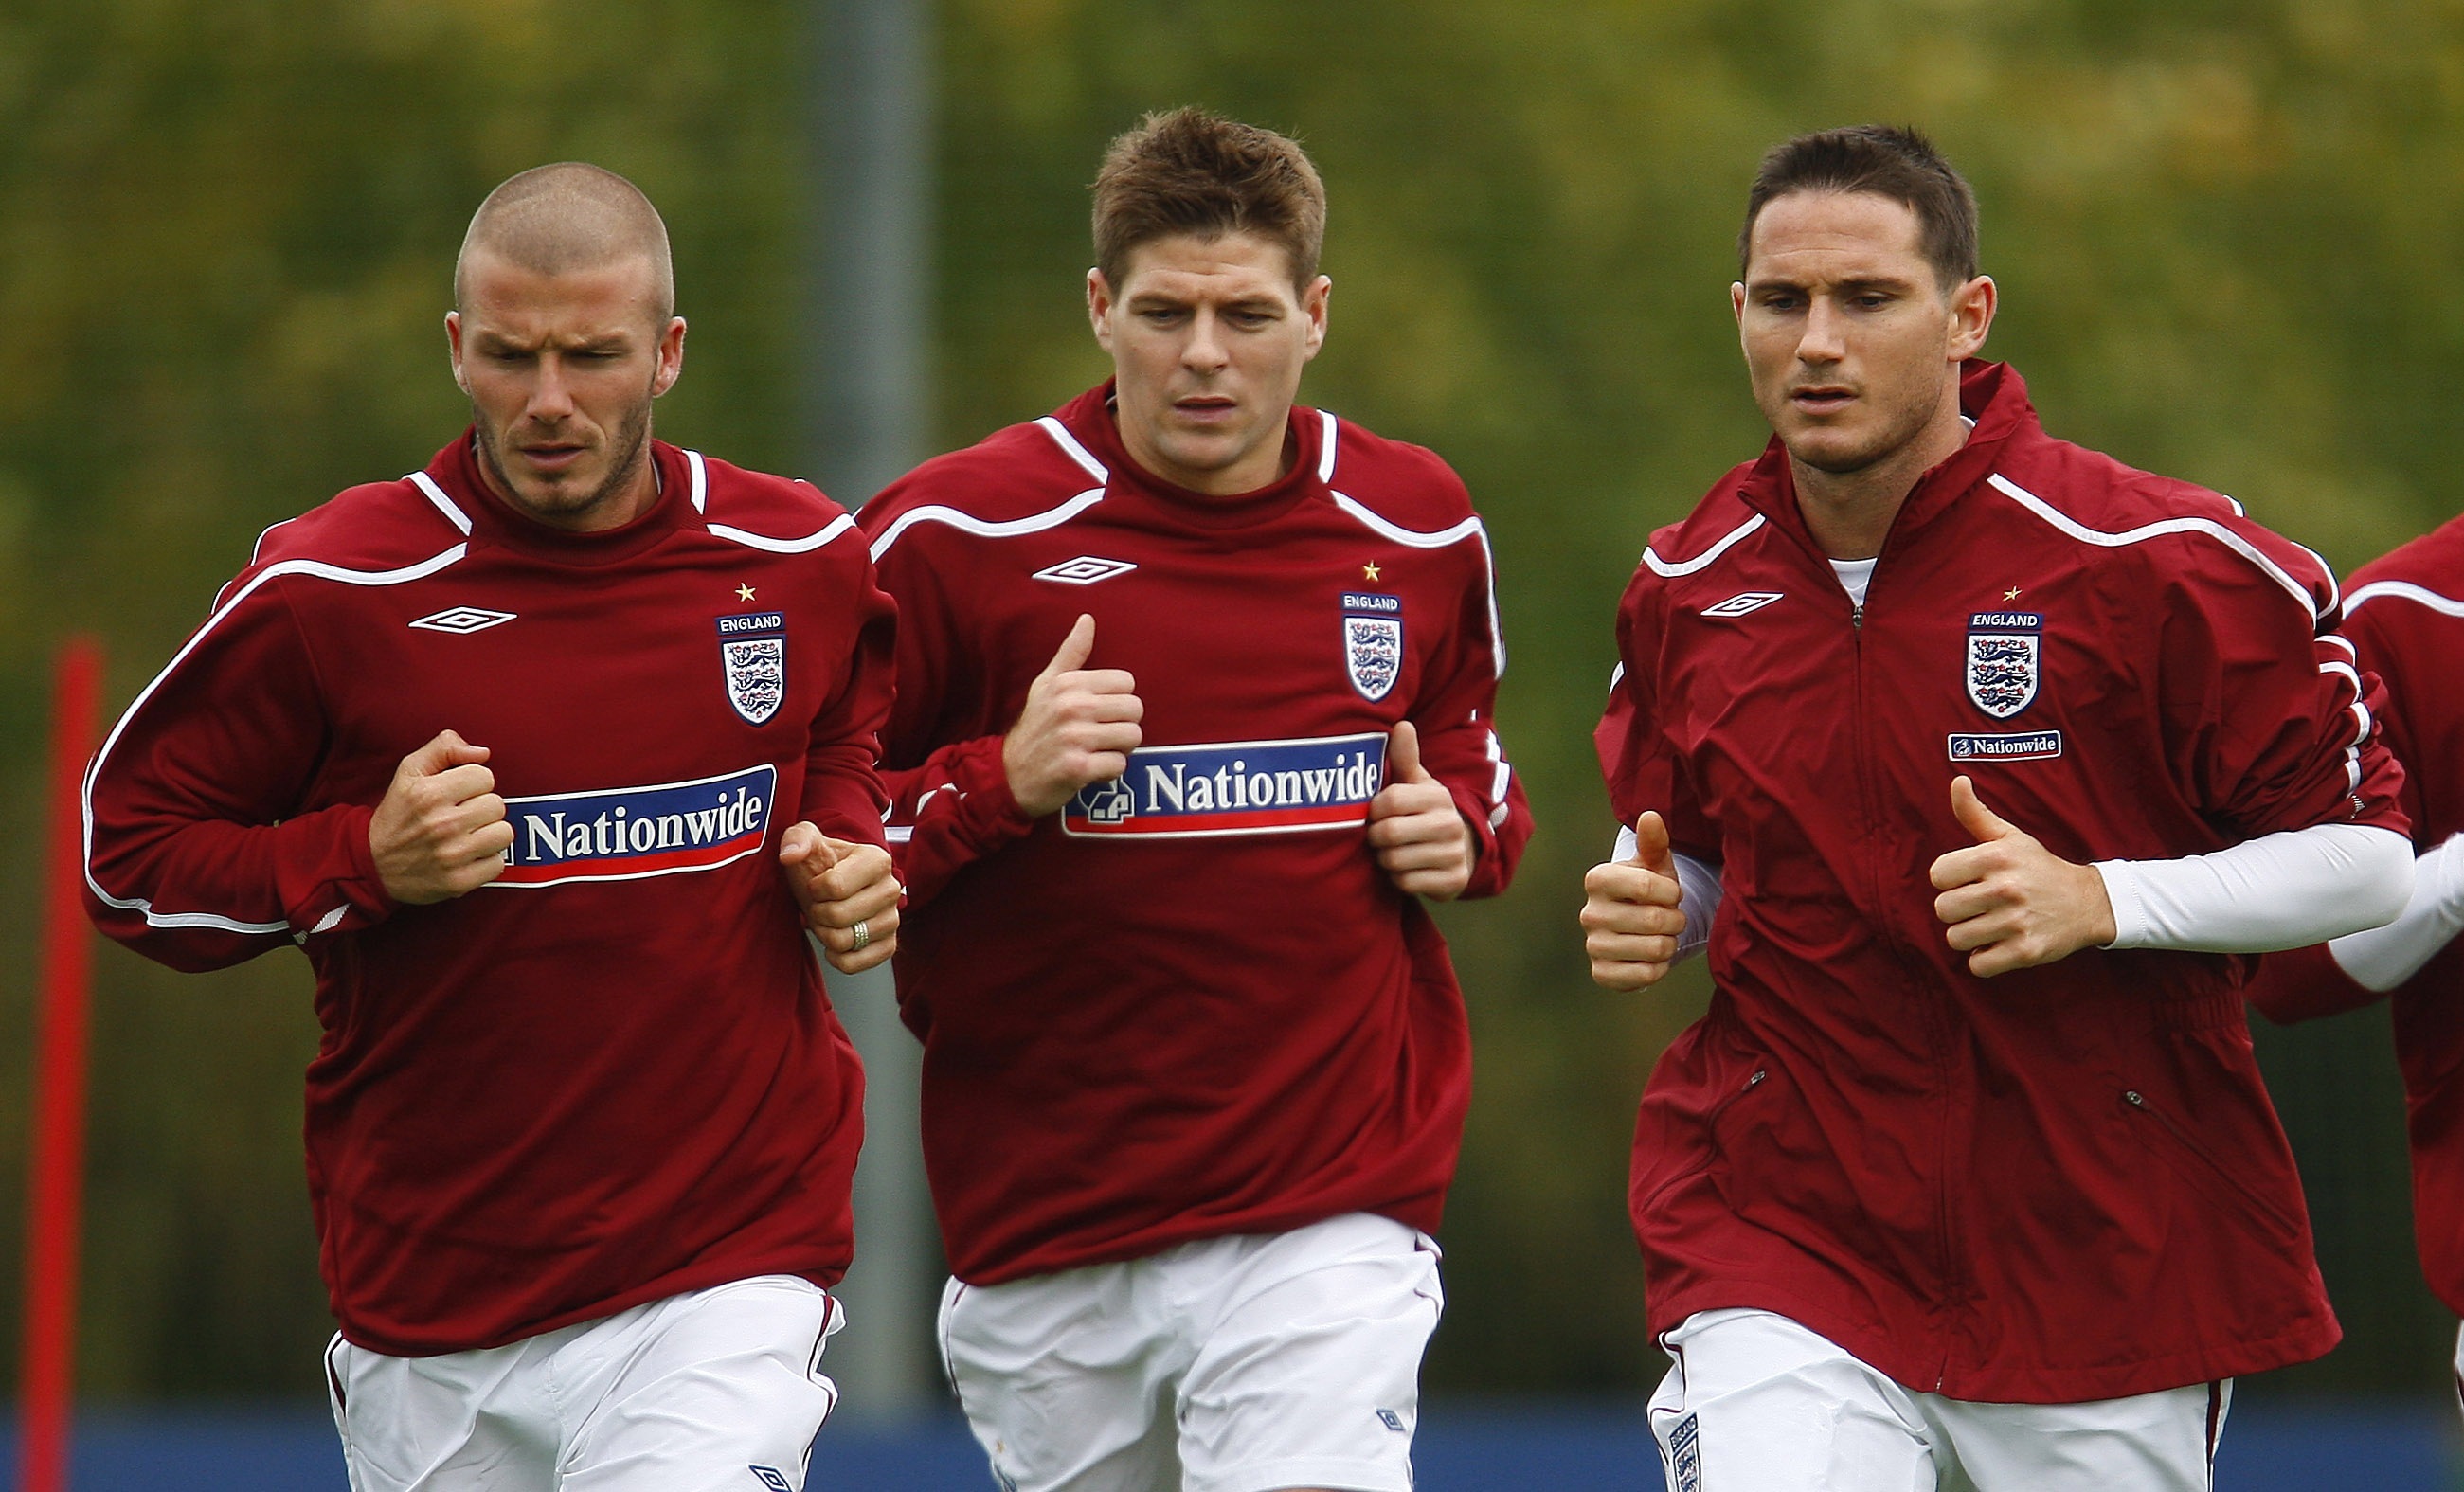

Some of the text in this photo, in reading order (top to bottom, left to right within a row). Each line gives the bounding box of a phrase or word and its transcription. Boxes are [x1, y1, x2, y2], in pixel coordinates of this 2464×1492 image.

[1344, 595, 1398, 610] ENGLAND
[720, 615, 781, 632] ENGLAND
[1972, 615, 2038, 626] ENGLAND
[1973, 737, 2056, 754] Nationwide
[1145, 751, 1378, 812] Nationwide
[523, 787, 762, 861] Nationwide
